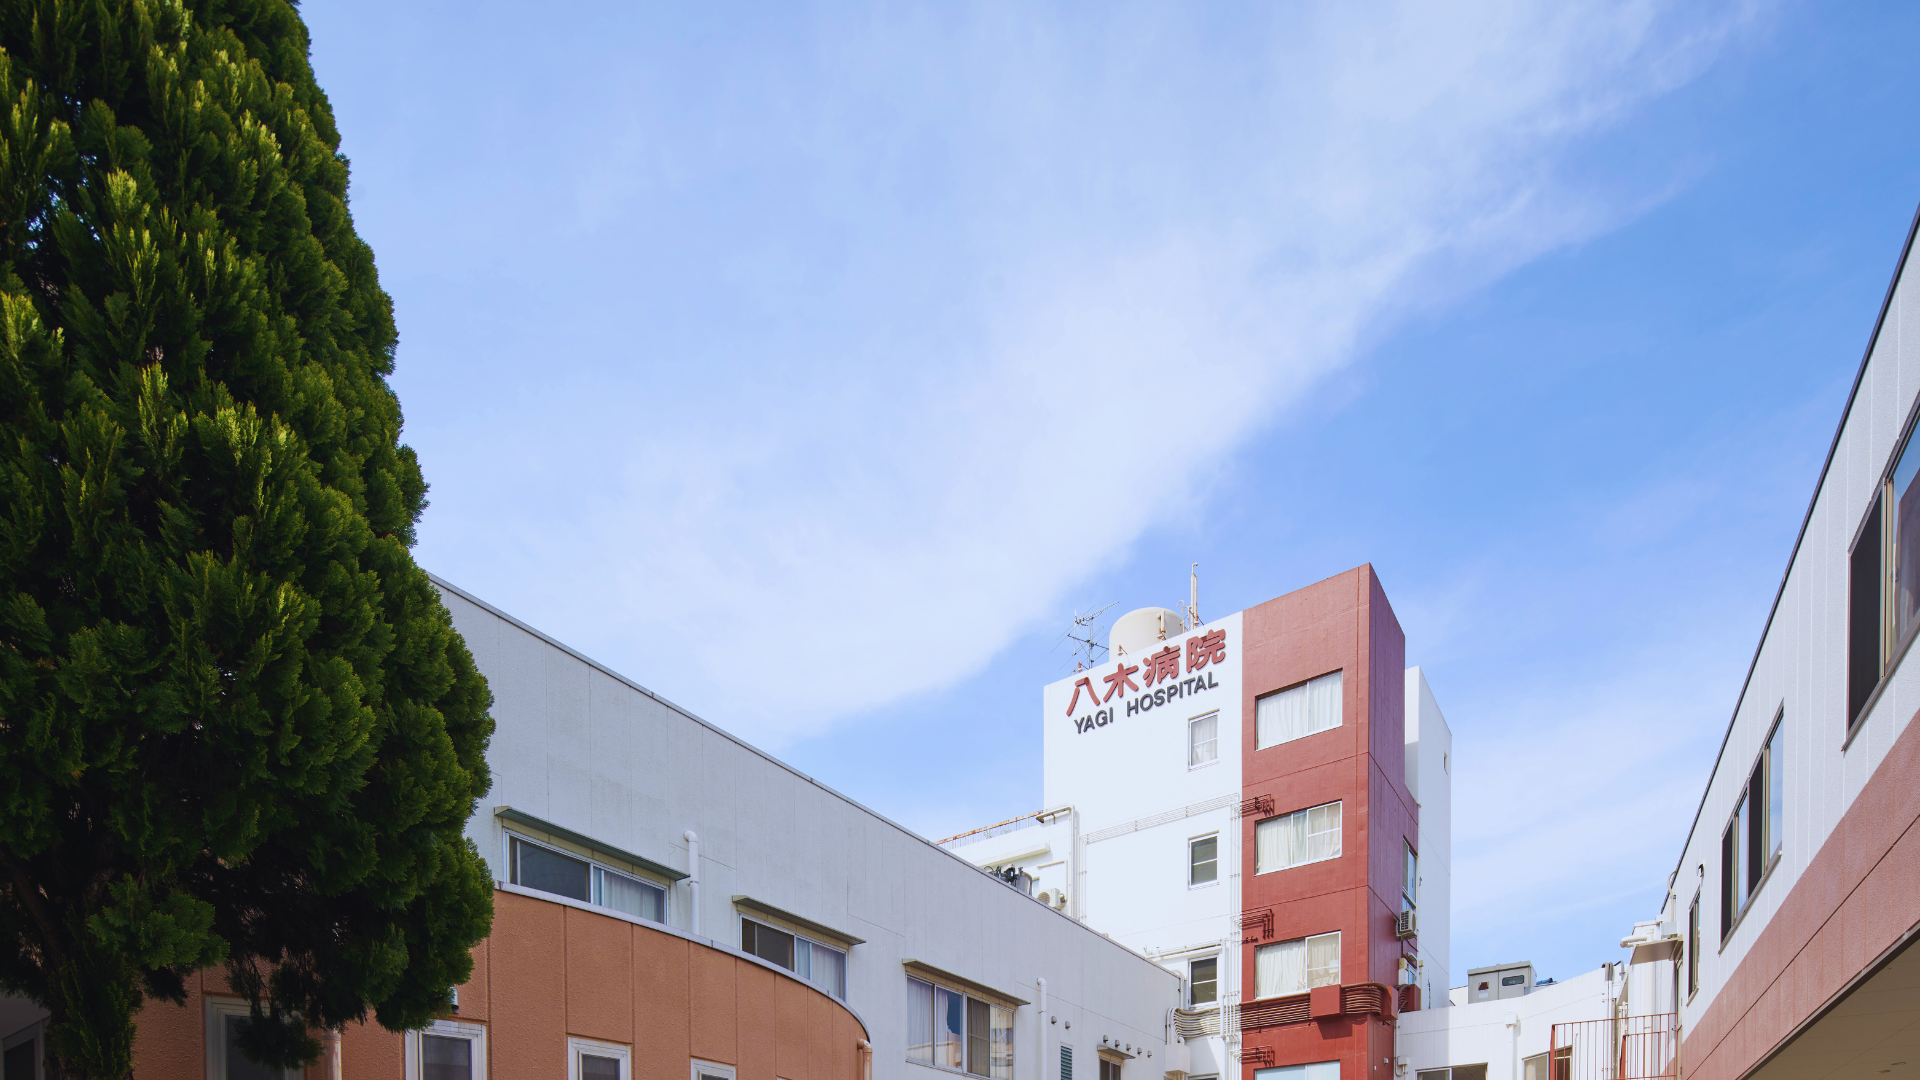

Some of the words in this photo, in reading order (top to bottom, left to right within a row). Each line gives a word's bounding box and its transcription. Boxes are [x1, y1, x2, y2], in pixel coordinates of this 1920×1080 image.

[1066, 628, 1226, 717] 八木病院
[1074, 706, 1114, 734] YAGI
[1126, 671, 1219, 717] HOSPITAL
